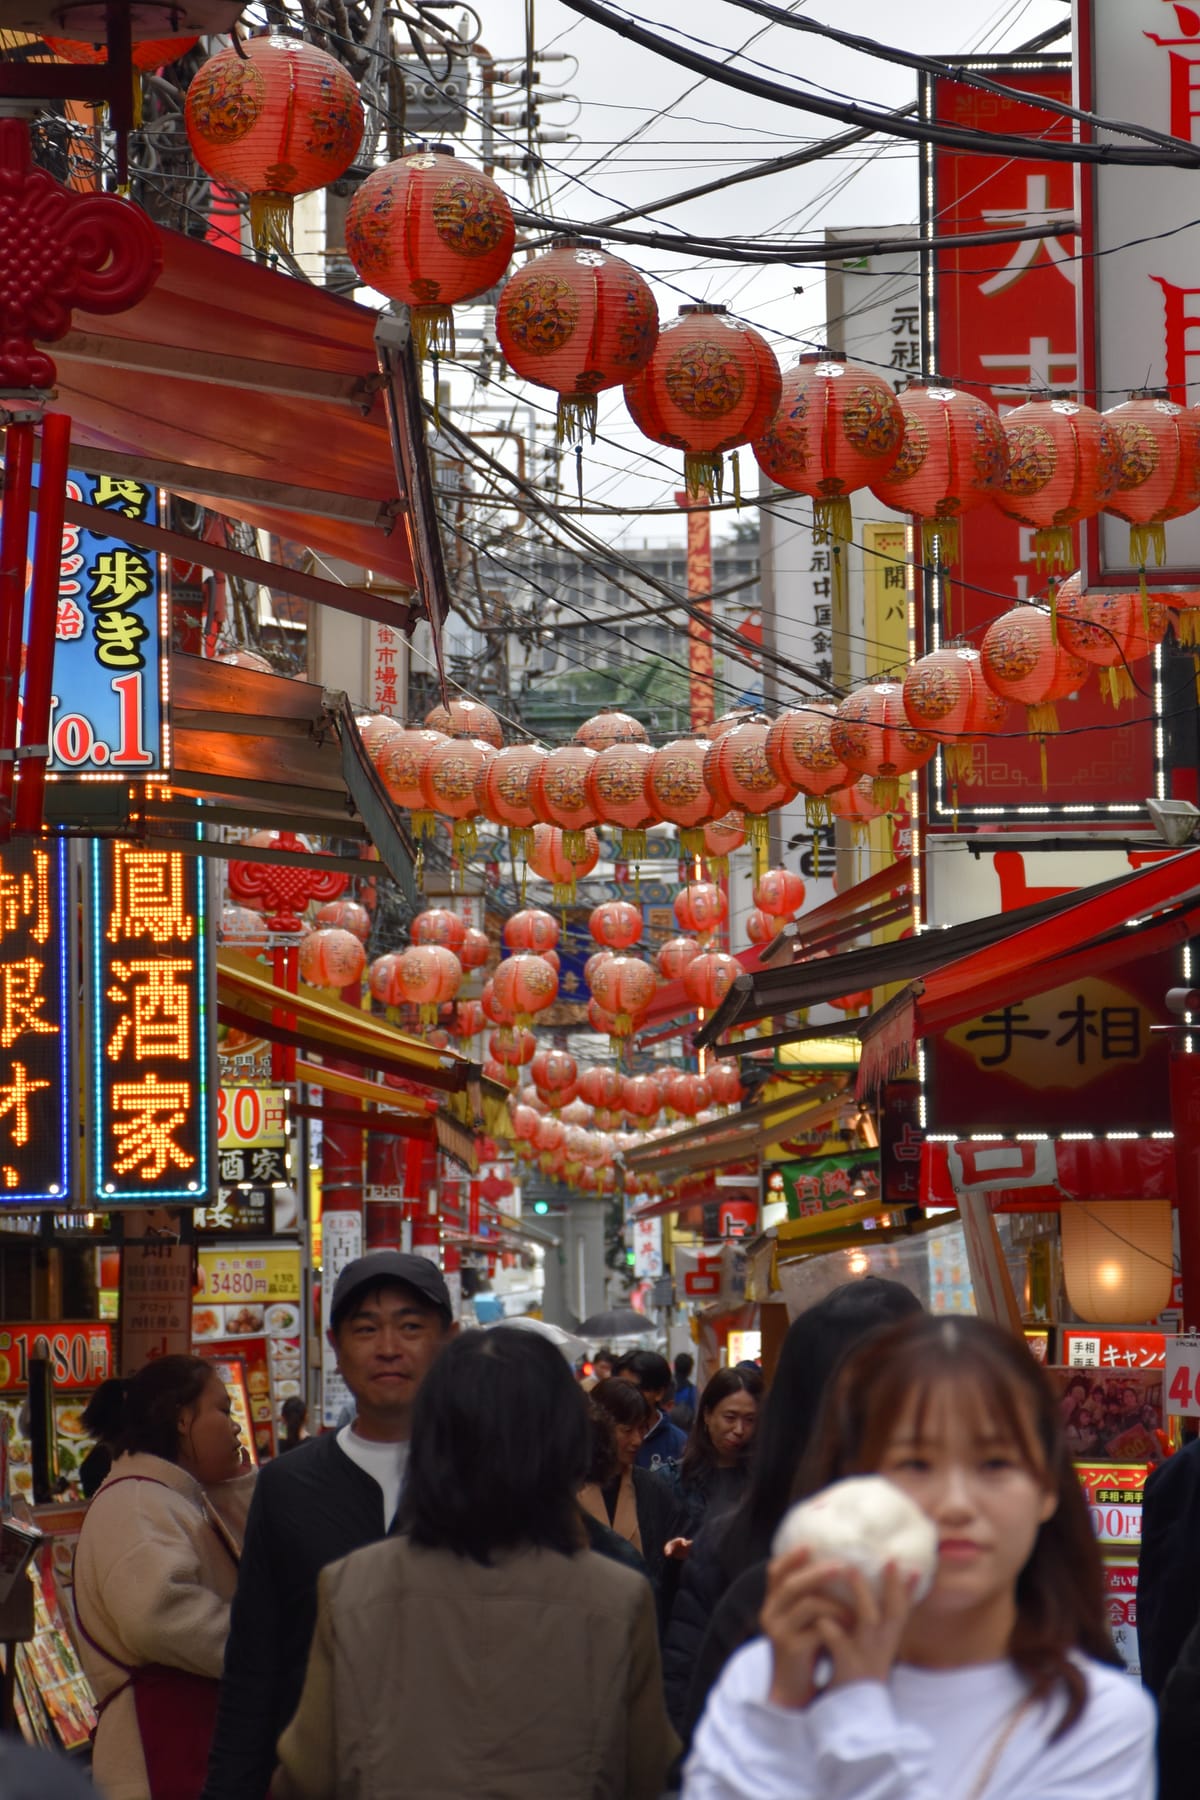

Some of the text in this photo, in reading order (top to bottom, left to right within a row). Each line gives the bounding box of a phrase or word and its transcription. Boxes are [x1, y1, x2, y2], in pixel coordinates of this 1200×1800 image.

[46, 672, 153, 767] o.1
[965, 993, 1141, 1066] 手相
[1073, 1342, 1095, 1353] 手相
[1168, 1366, 1200, 1409] 4
